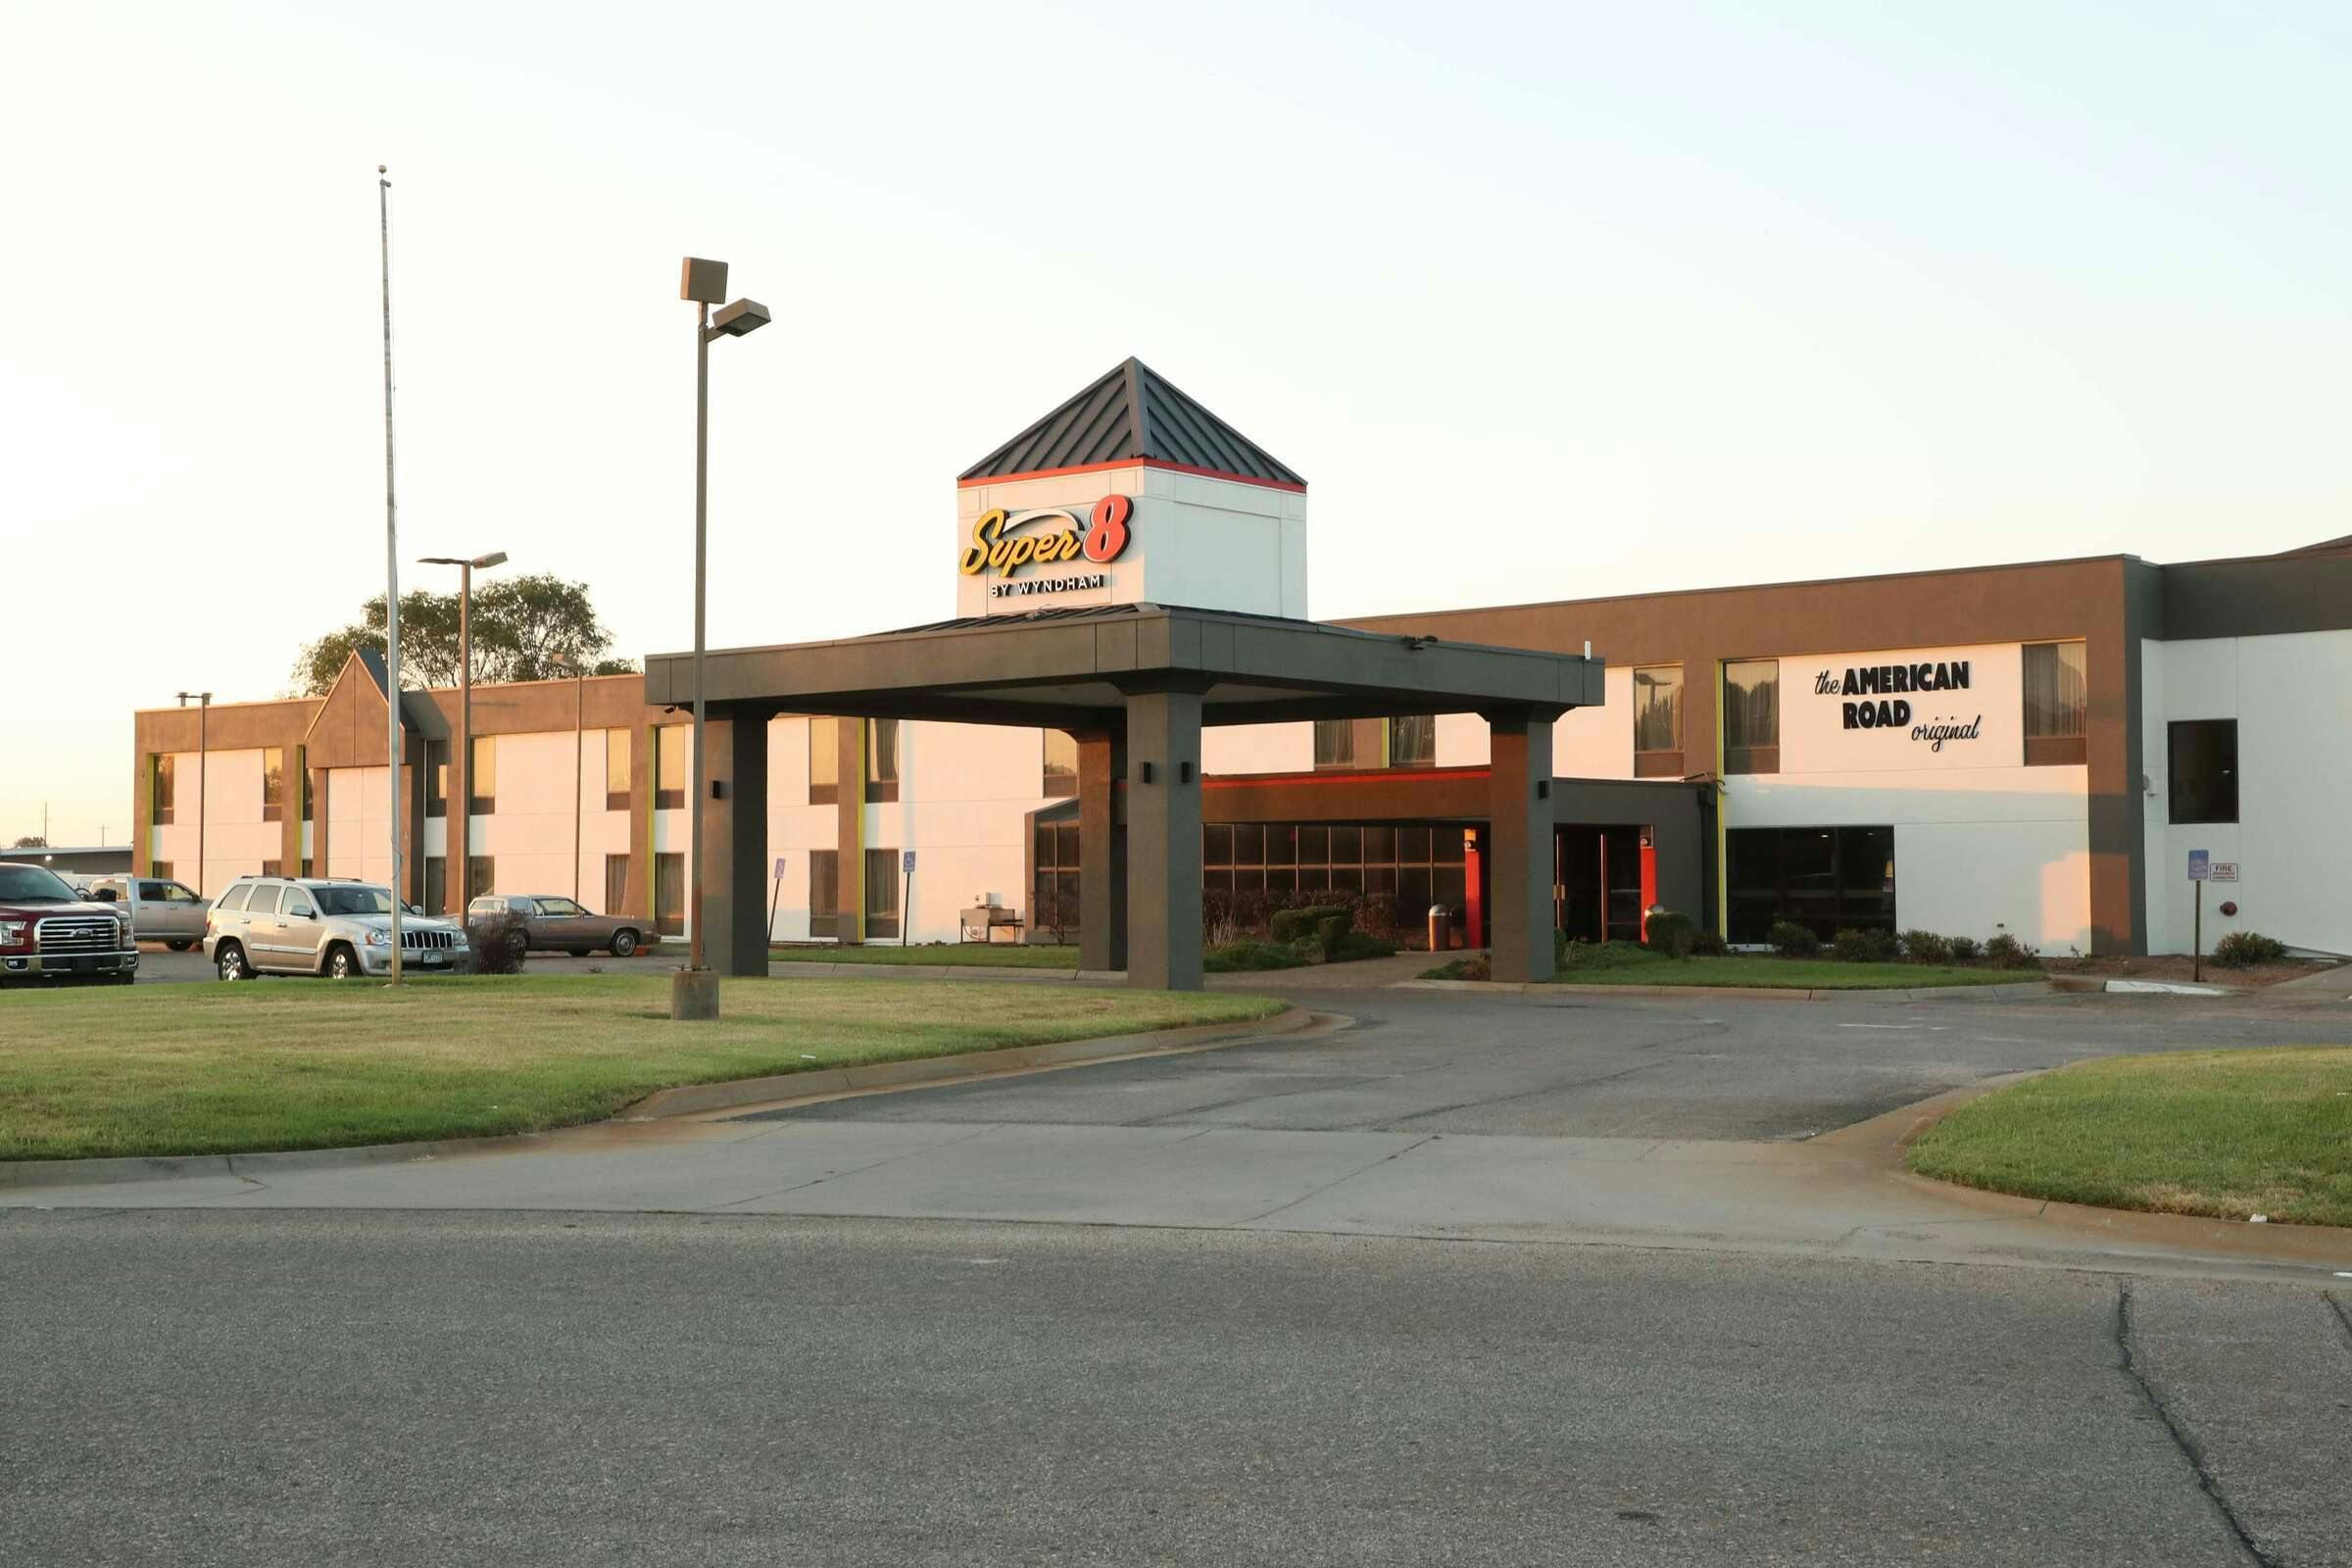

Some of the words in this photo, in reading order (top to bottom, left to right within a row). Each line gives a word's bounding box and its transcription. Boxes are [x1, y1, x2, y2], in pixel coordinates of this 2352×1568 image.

[960, 508, 1082, 577] Super
[1083, 494, 1134, 563] 8
[990, 583, 1010, 597] BY
[1018, 574, 1103, 595] WYNDHAM
[1814, 669, 1840, 695] the
[1841, 661, 1970, 696] AMERICAN
[1842, 700, 1911, 729] ROAD
[1911, 714, 1981, 753] original
